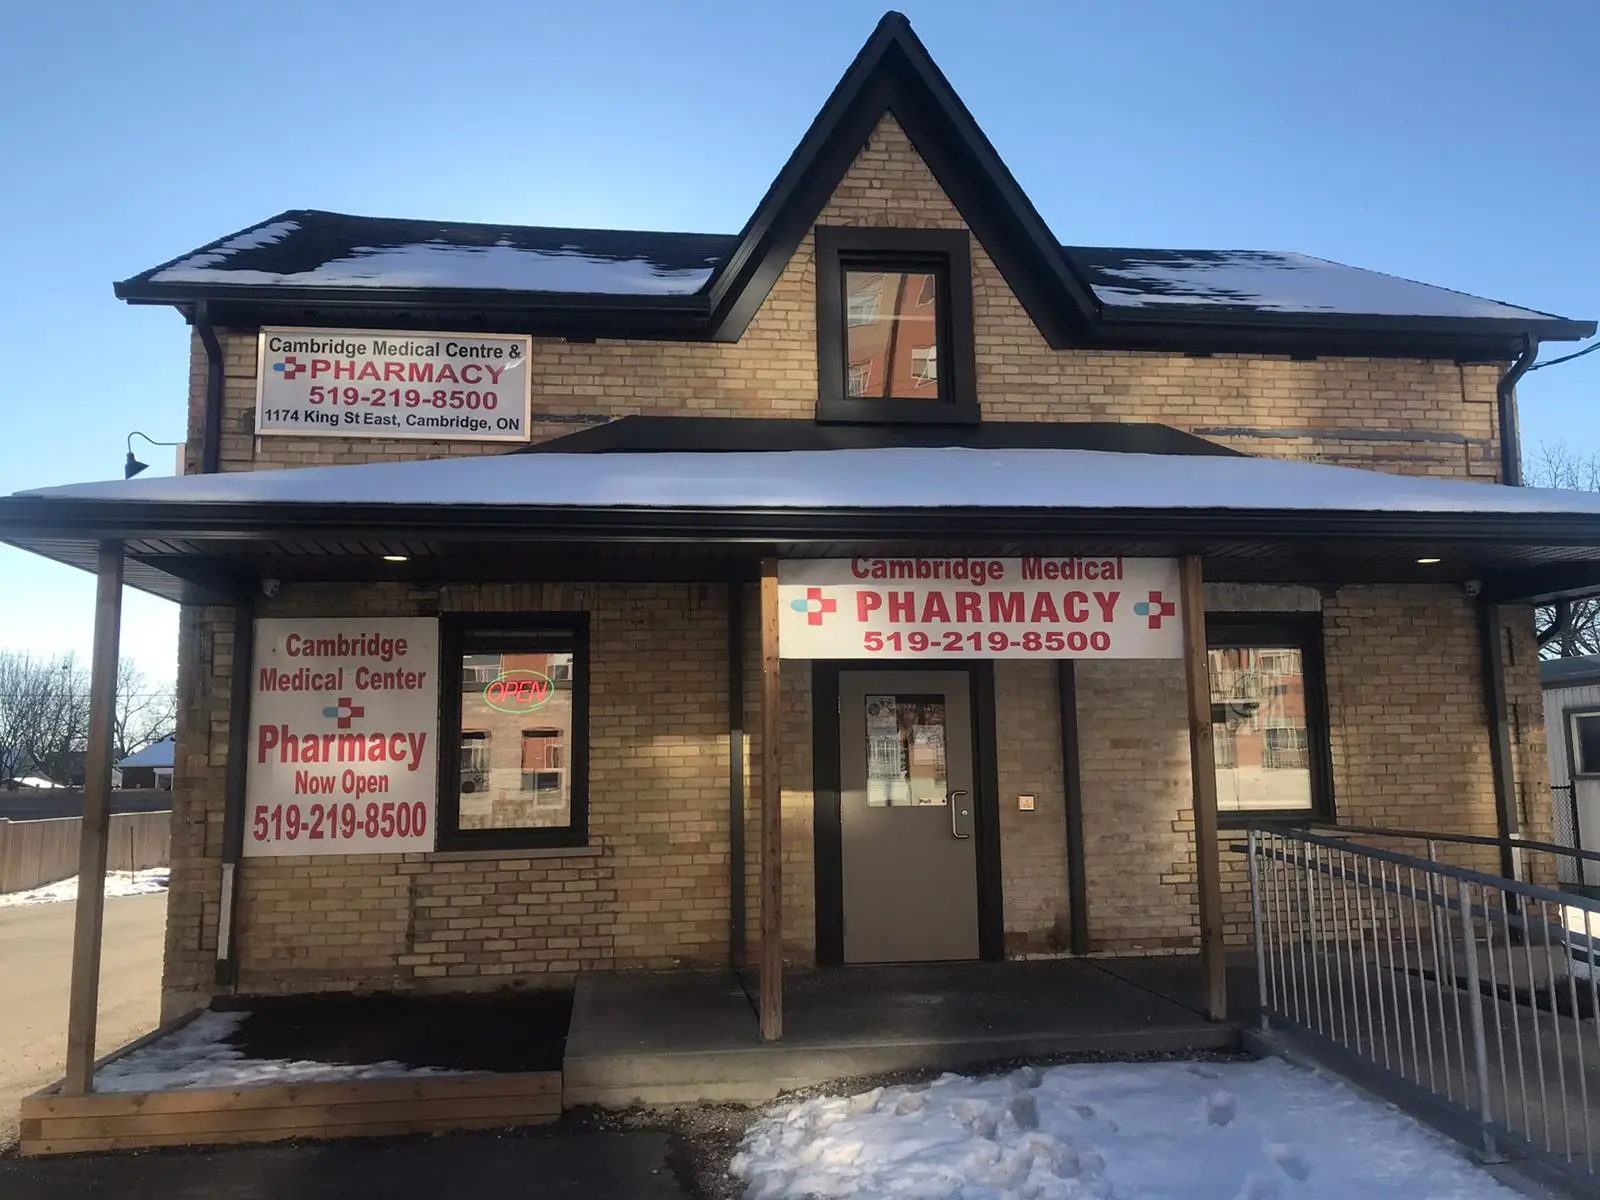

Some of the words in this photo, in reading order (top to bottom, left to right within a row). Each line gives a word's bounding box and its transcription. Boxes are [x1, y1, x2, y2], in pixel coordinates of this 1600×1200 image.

[269, 337, 366, 358] Cambridge
[372, 340, 440, 357] Medical
[445, 342, 503, 359] Centre
[509, 344, 521, 359] &
[310, 359, 505, 385] PHARMACY
[309, 386, 498, 410] 519-219-8500
[265, 409, 299, 422] 1174
[304, 410, 339, 426] King
[344, 412, 361, 424] St
[364, 413, 401, 428] East,
[406, 414, 491, 430] Cambridge,
[497, 417, 519, 430] ON
[851, 557, 1004, 586] Cambridge
[1021, 557, 1123, 580] Medical
[856, 591, 1121, 624] PHARMACY
[286, 633, 408, 662] Cambridge
[864, 631, 1111, 653] 519-219-8500
[260, 667, 343, 692] Medical
[355, 666, 427, 690] Center
[486, 680, 549, 704] OPEN
[258, 724, 427, 772] Pharmacy
[295, 770, 336, 794] Now
[342, 769, 390, 800] Open
[253, 801, 427, 841] 519-219-8500
